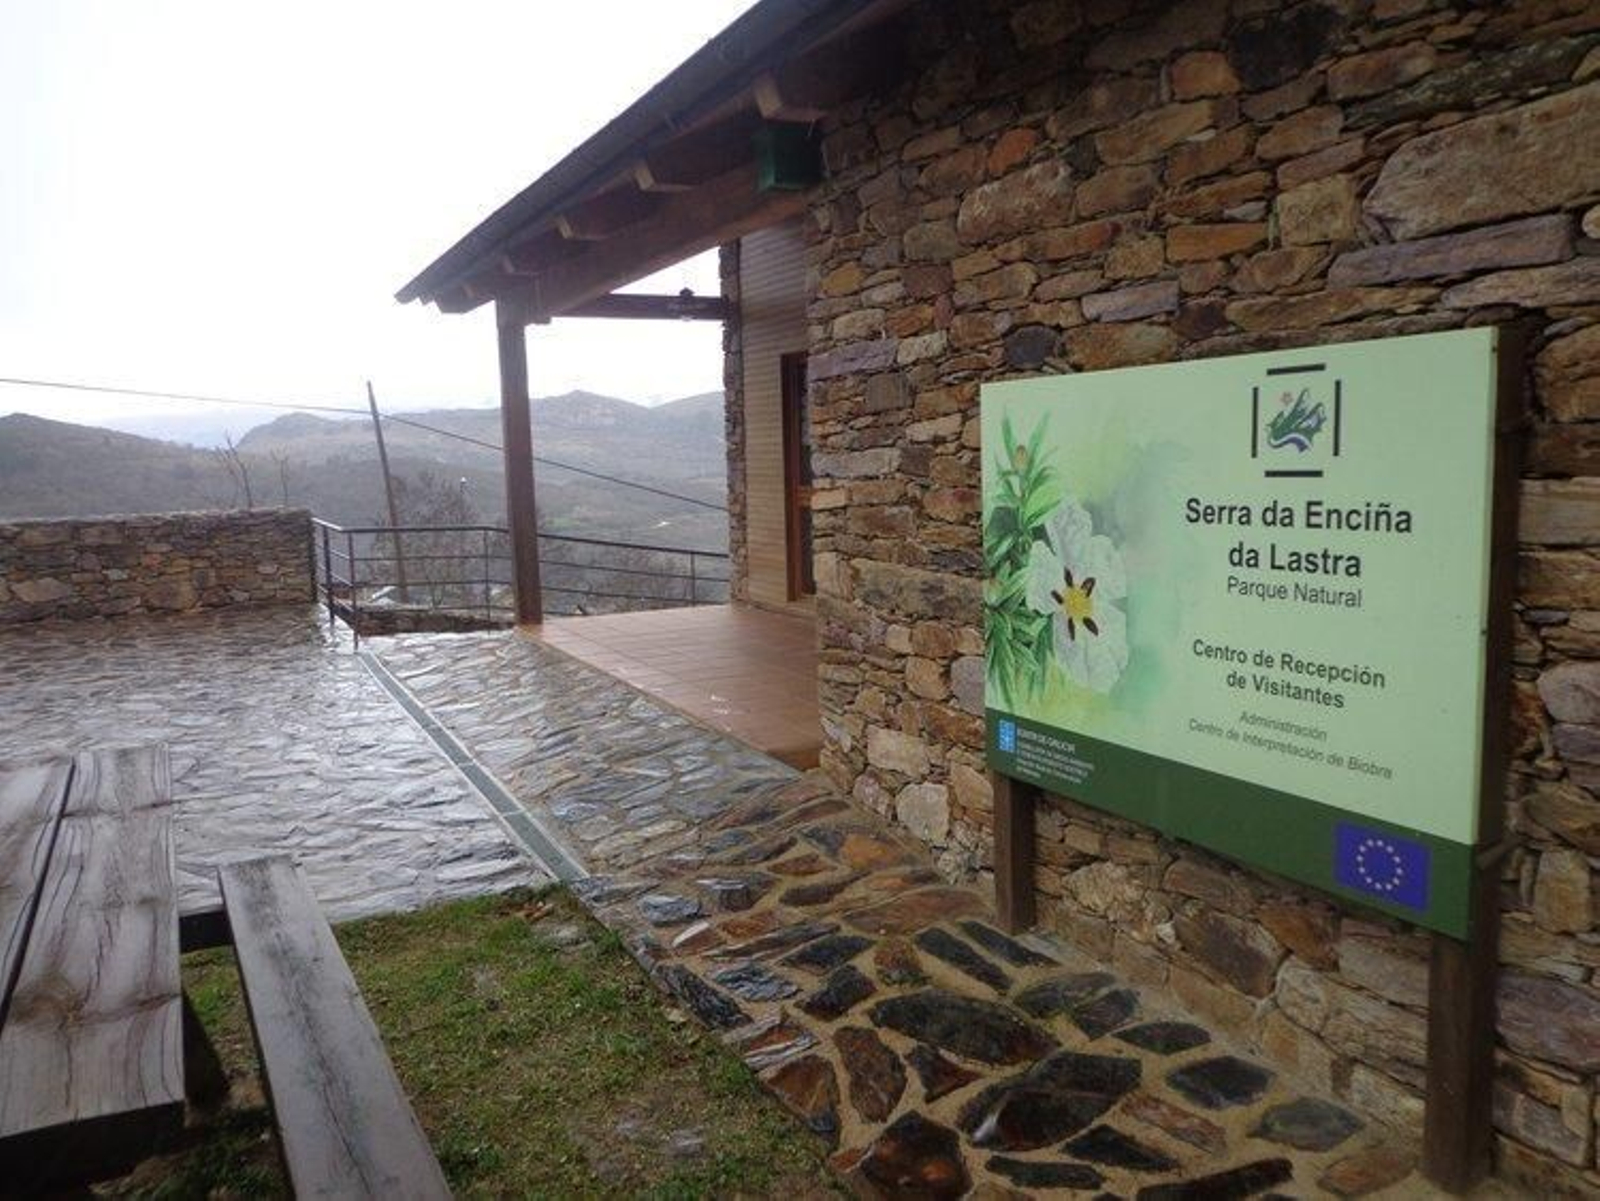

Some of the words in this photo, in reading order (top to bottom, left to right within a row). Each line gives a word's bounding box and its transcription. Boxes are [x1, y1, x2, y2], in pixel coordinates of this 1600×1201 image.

[1185, 497, 1251, 526] Serra
[1261, 500, 1294, 528] da
[1305, 500, 1412, 533] Enciña
[1228, 541, 1259, 569] da
[1270, 543, 1361, 577] Lastra
[1227, 576, 1288, 602] Parque
[1294, 582, 1362, 608] Natural
[1193, 639, 1248, 664] Centro
[1253, 650, 1274, 669] de
[1281, 653, 1386, 688] Recepción
[1226, 671, 1247, 689] de
[1252, 674, 1345, 709] Visitantes
[1239, 711, 1328, 742] Administración
[1189, 718, 1225, 739] Centro
[1226, 728, 1240, 741] de
[1243, 732, 1325, 763] Interpretación
[1326, 753, 1344, 768] de
[1347, 756, 1393, 780] Biobra
